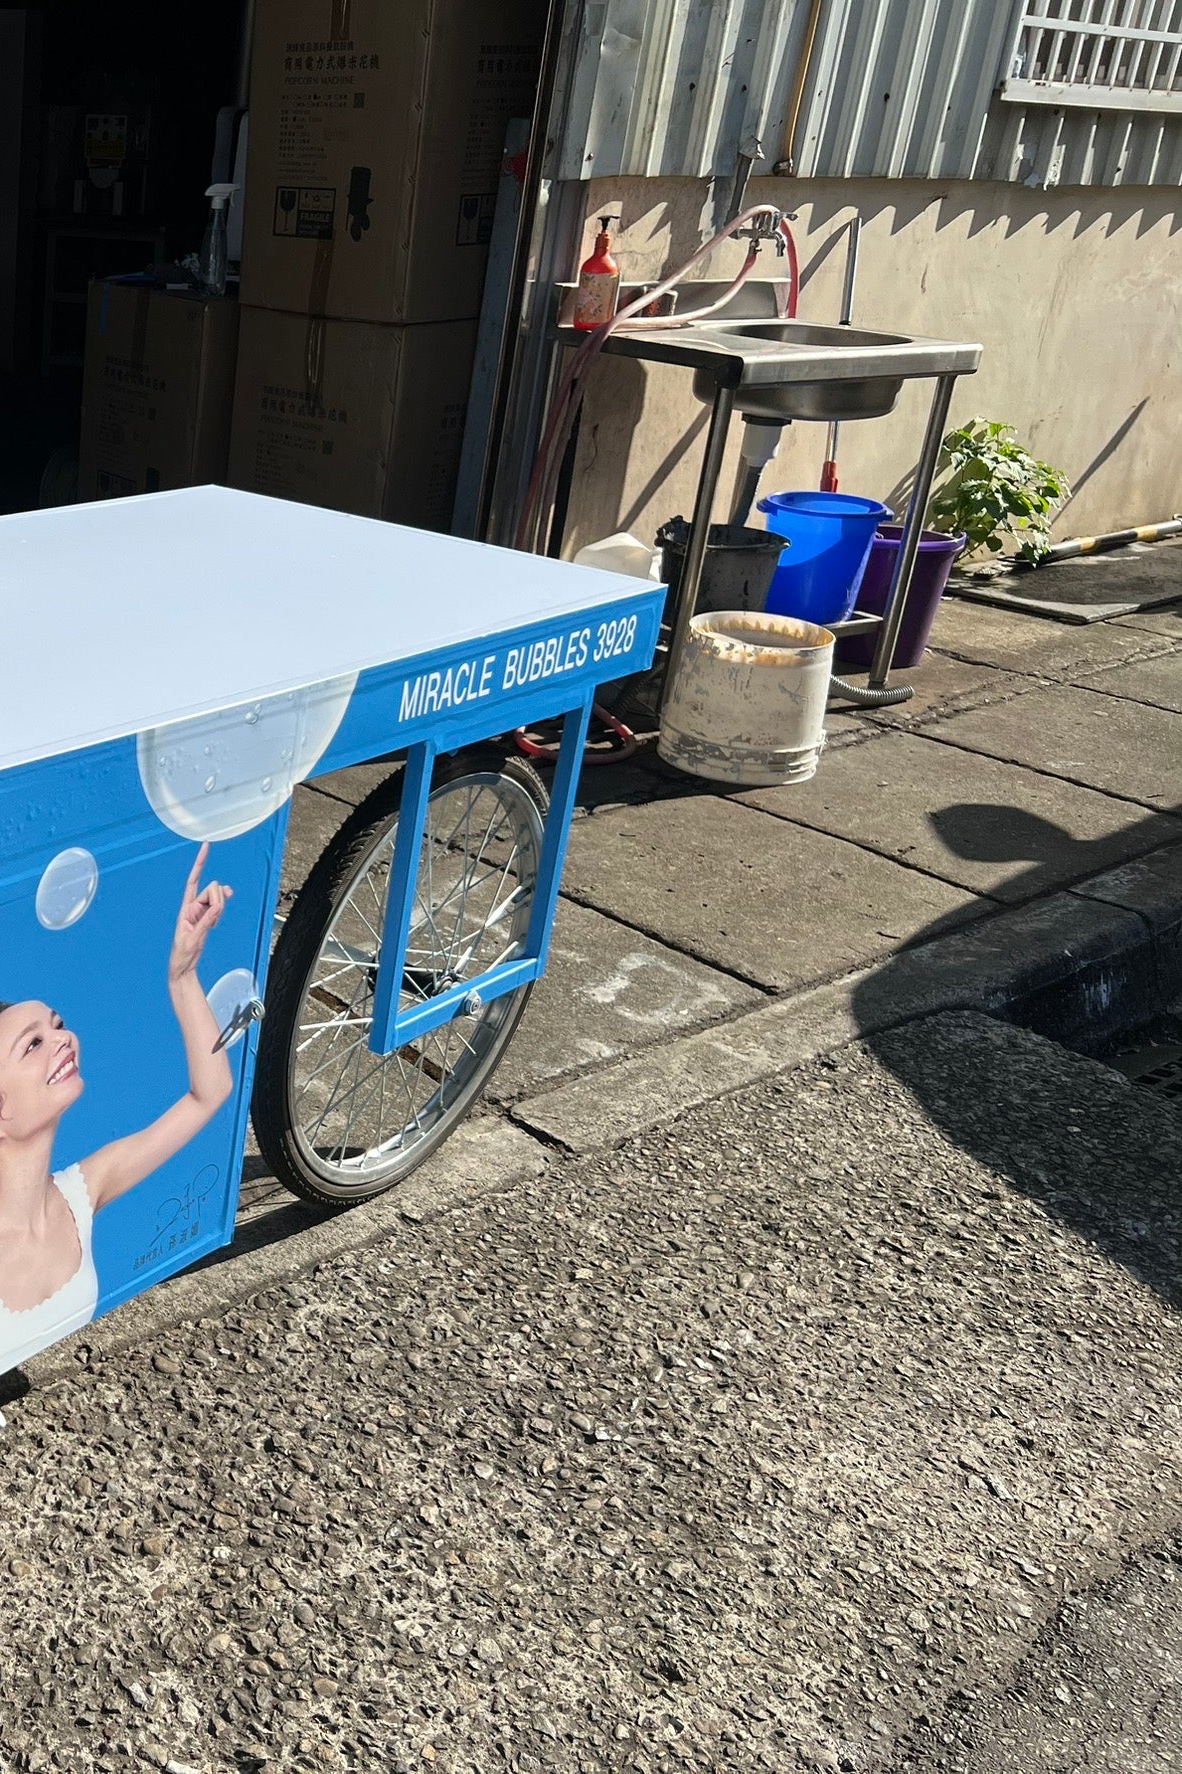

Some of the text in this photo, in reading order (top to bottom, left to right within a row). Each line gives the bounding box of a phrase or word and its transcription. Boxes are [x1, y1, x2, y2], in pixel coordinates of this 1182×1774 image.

[398, 614, 637, 722] MIRACLE BUBBLES 3928
